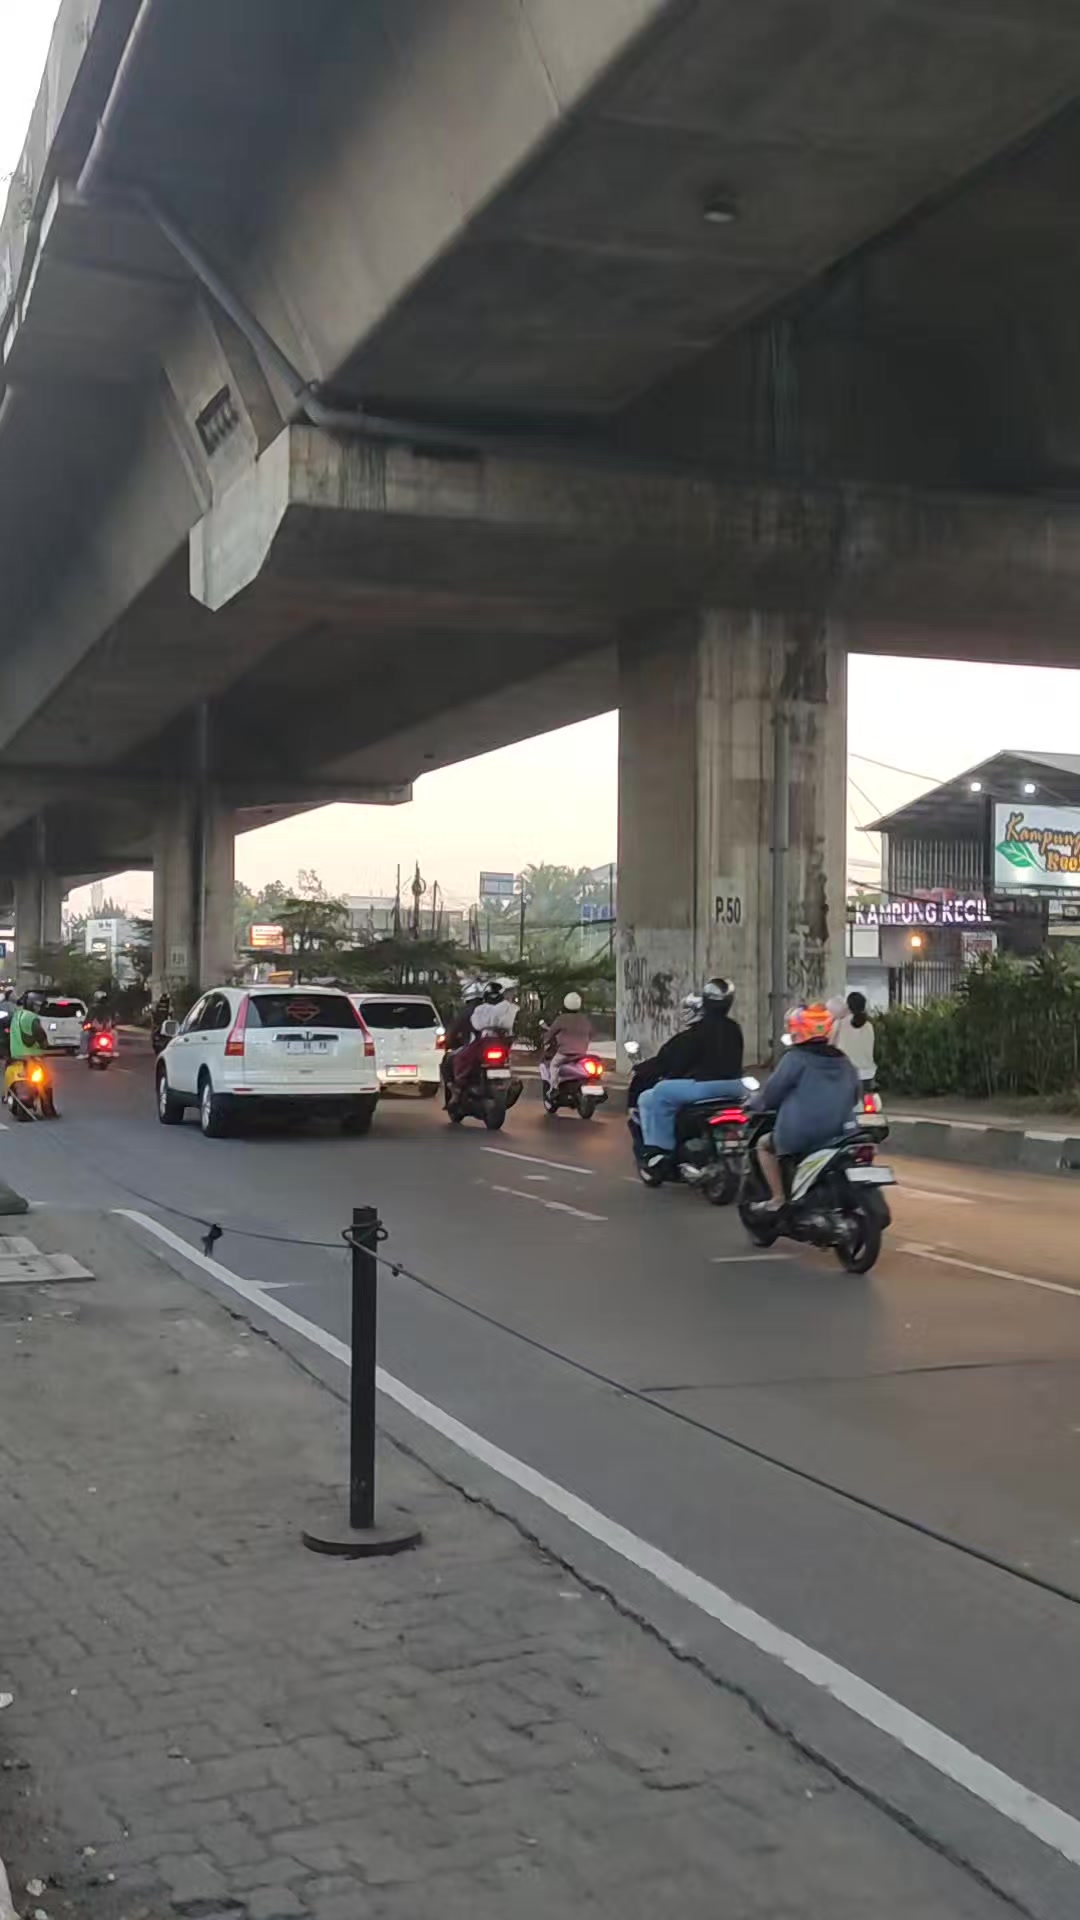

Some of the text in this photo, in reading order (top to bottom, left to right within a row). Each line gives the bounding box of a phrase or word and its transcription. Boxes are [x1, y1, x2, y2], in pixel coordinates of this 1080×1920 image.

[715, 895, 742, 925] P.50
[856, 899, 992, 924] KAMPUNG KECIL
